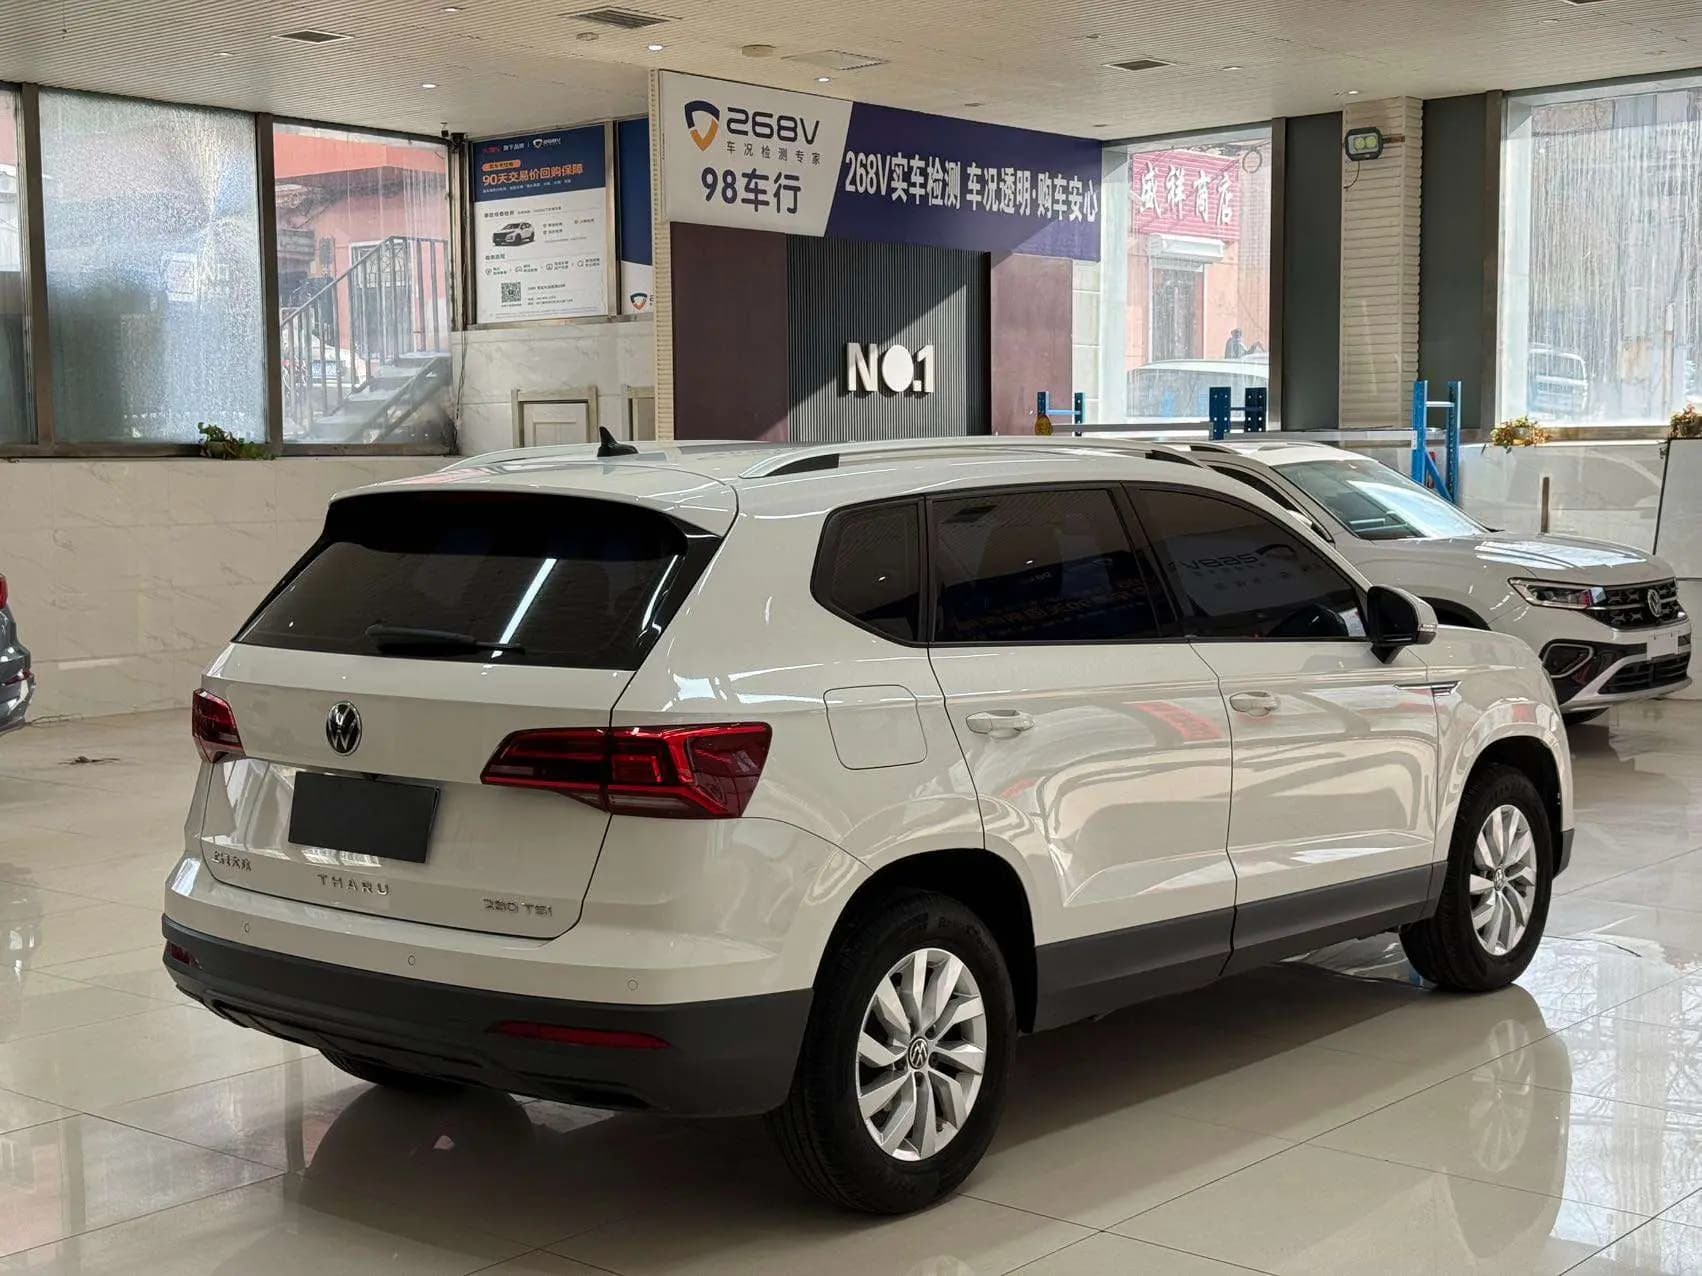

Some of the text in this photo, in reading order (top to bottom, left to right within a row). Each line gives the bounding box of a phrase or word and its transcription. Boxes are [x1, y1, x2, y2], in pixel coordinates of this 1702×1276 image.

[726, 106, 820, 145] 268V
[726, 141, 821, 165] 车况检测专家
[482, 163, 584, 187] 90天交易价回购保障
[701, 166, 802, 214] 98车行
[845, 150, 961, 210] 268V实车检测
[846, 342, 935, 393] NO.1
[316, 873, 391, 897] THARU
